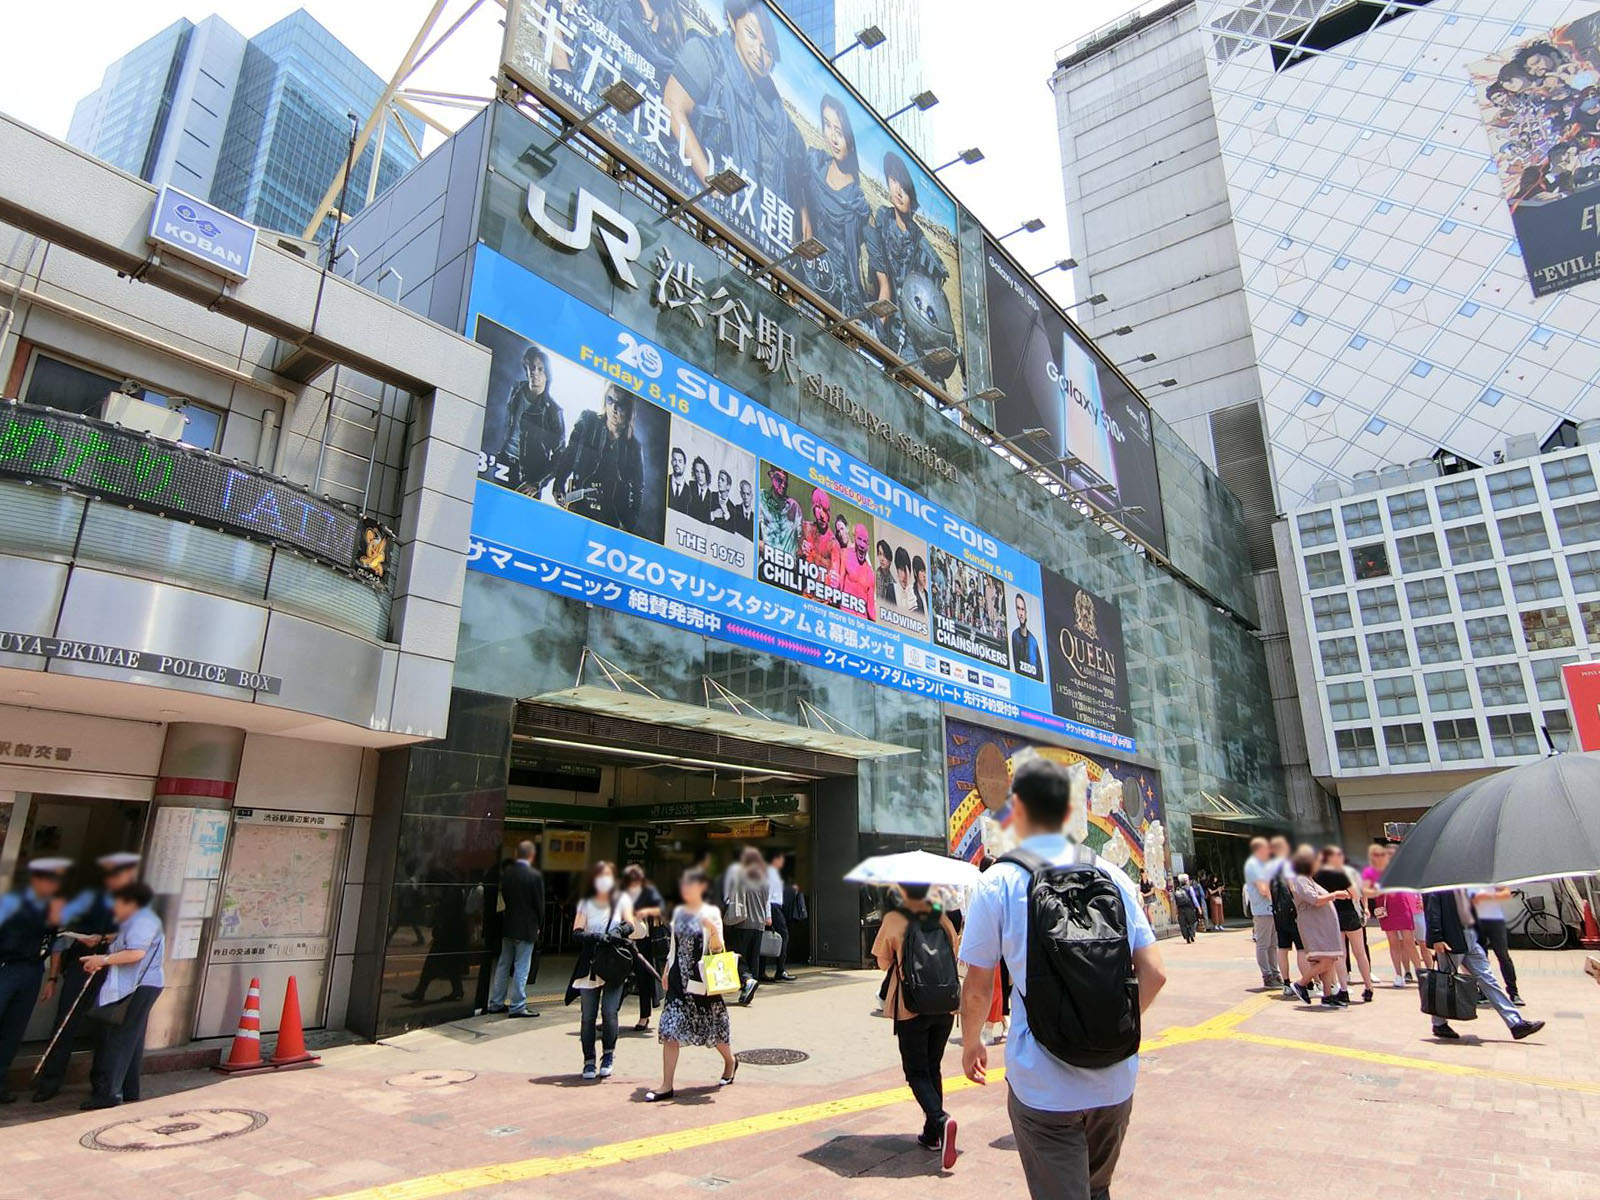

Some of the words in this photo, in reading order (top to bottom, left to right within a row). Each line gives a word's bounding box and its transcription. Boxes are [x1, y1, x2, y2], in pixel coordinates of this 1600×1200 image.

[524, 51, 635, 144] ウルトラギガモスター+
[164, 222, 242, 267] KOBAN
[527, 183, 642, 289] JR
[654, 247, 797, 384] 渋谷駅
[579, 345, 644, 392] Friday
[648, 383, 690, 414] 8.16
[1046, 361, 1099, 426] Galaxy
[676, 367, 842, 475] SUMMER
[849, 464, 937, 528] SONIC
[943, 516, 998, 558] 2019
[676, 528, 707, 555] THE
[711, 543, 746, 567] 1975
[764, 543, 795, 569] RED
[799, 558, 828, 582] HOT
[963, 547, 994, 575] Sunday
[467, 538, 622, 601] サマーソニック
[628, 589, 721, 632] 絶賛発売中
[763, 562, 803, 591] CHILI
[806, 578, 867, 614] PEPPERS
[880, 606, 928, 636] RADWIMPS
[936, 614, 956, 633] THE
[936, 629, 1008, 666] CHAINSMOKERS
[1060, 627, 1116, 679] QUEEN
[160, 657, 227, 683] POLICE
[239, 672, 271, 691] BOX
[264, 813, 326, 825] 渋谷駅周辺案内図
[625, 831, 649, 849] JR
